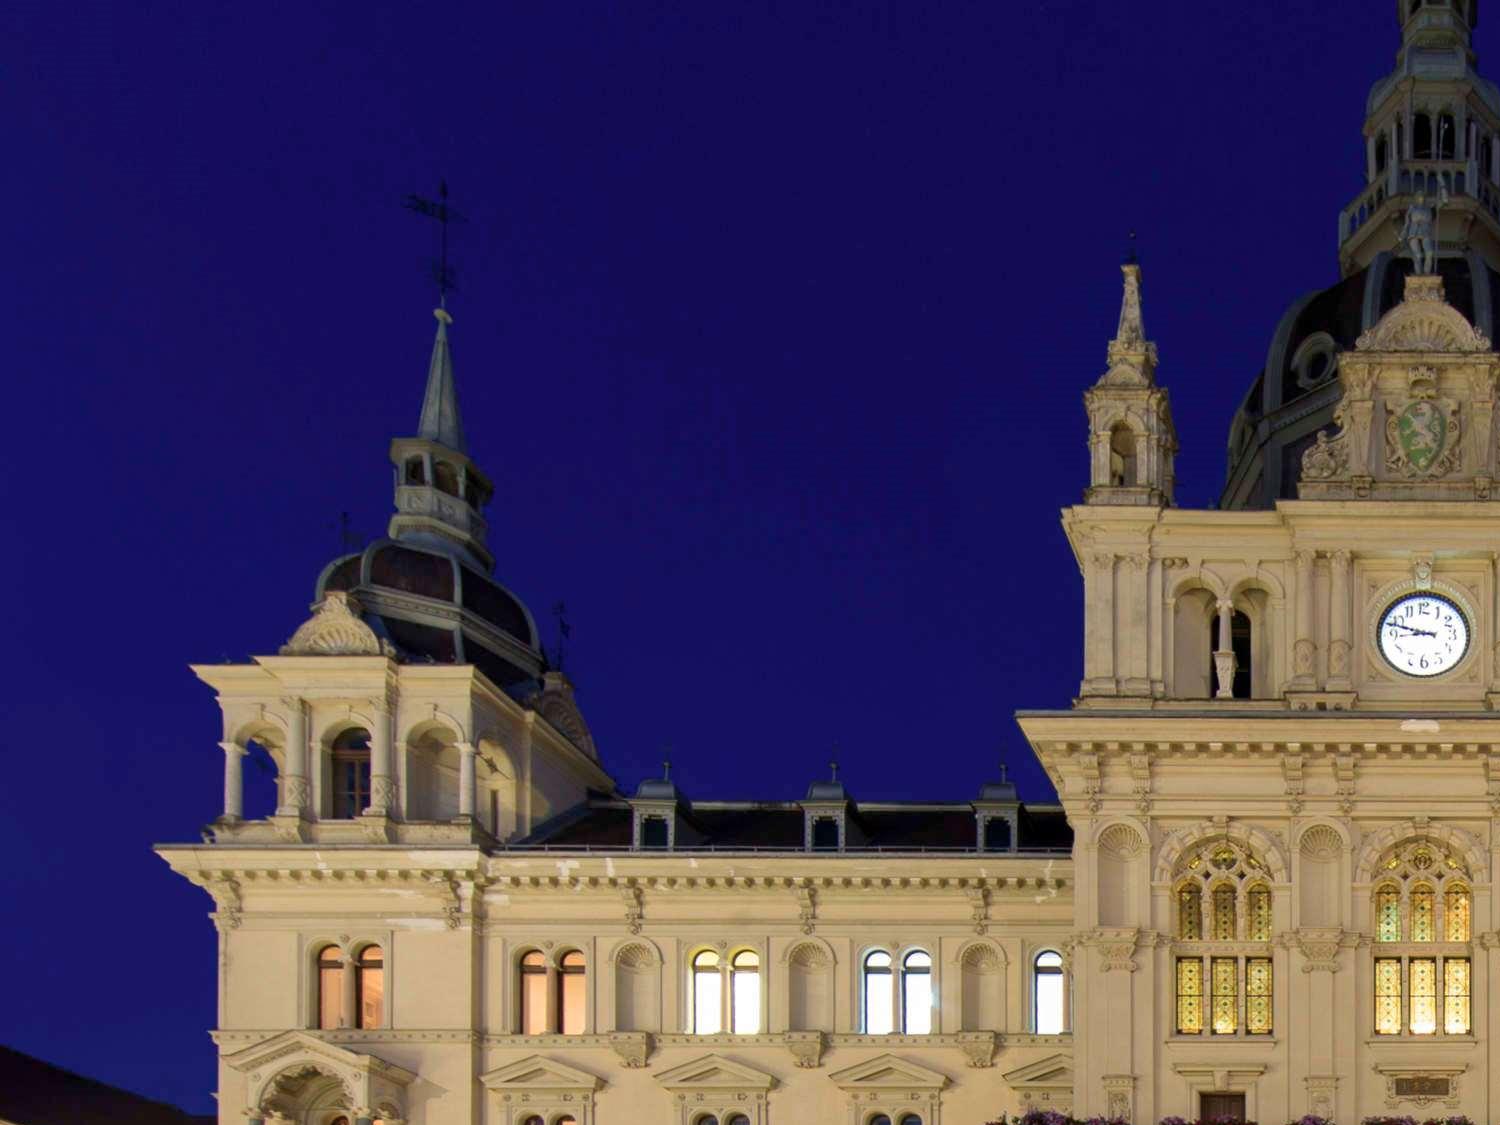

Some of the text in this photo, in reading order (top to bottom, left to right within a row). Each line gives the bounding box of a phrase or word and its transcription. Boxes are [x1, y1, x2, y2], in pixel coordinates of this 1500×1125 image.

[1404, 605, 1414, 618] 11
[1418, 601, 1430, 616] 12
[1435, 606, 1441, 620] 1
[1444, 615, 1453, 628] 2
[1389, 628, 1398, 641] 9
[1448, 628, 1457, 640] 3
[1419, 653, 1429, 669] 6
